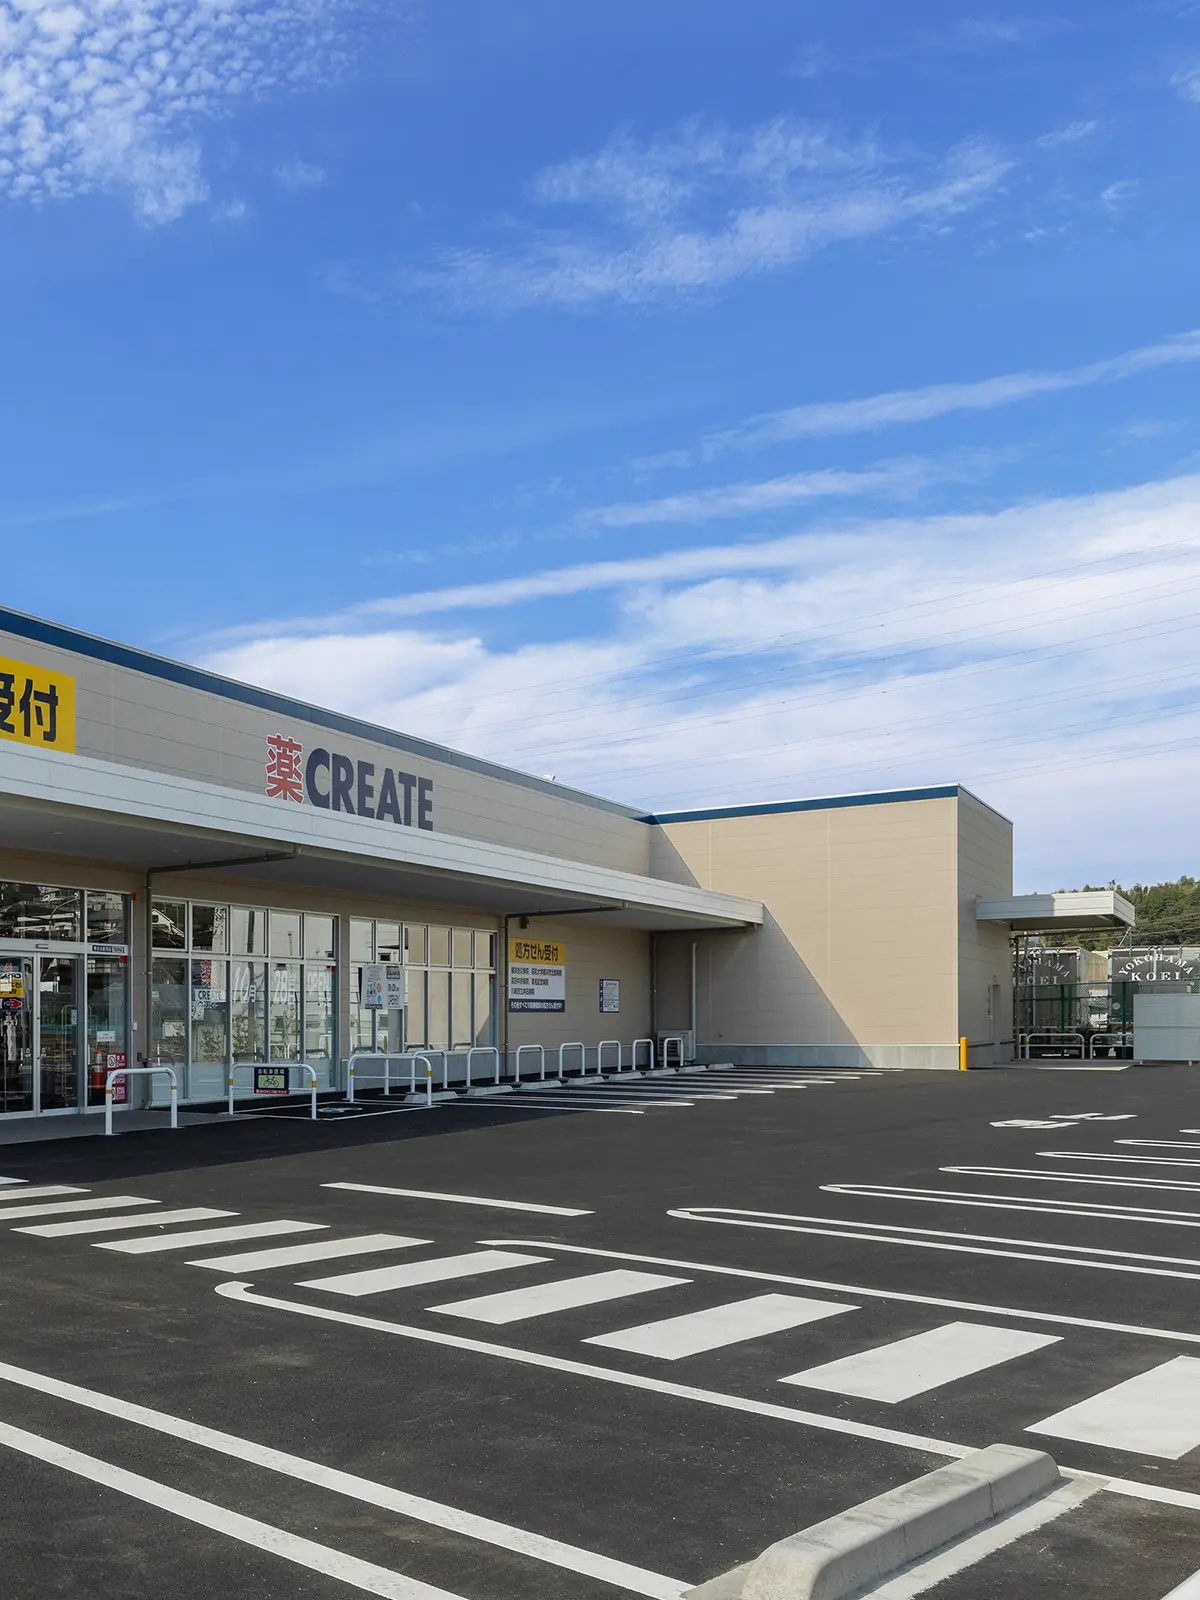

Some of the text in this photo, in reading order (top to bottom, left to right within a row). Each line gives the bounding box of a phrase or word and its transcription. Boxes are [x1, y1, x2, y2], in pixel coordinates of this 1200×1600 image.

[265, 733, 434, 832] 薬 CREATE
[514, 941, 559, 962] 処方せん受付
[1118, 953, 1194, 976] YOKOHAMA
[1131, 971, 1181, 982] KOEI
